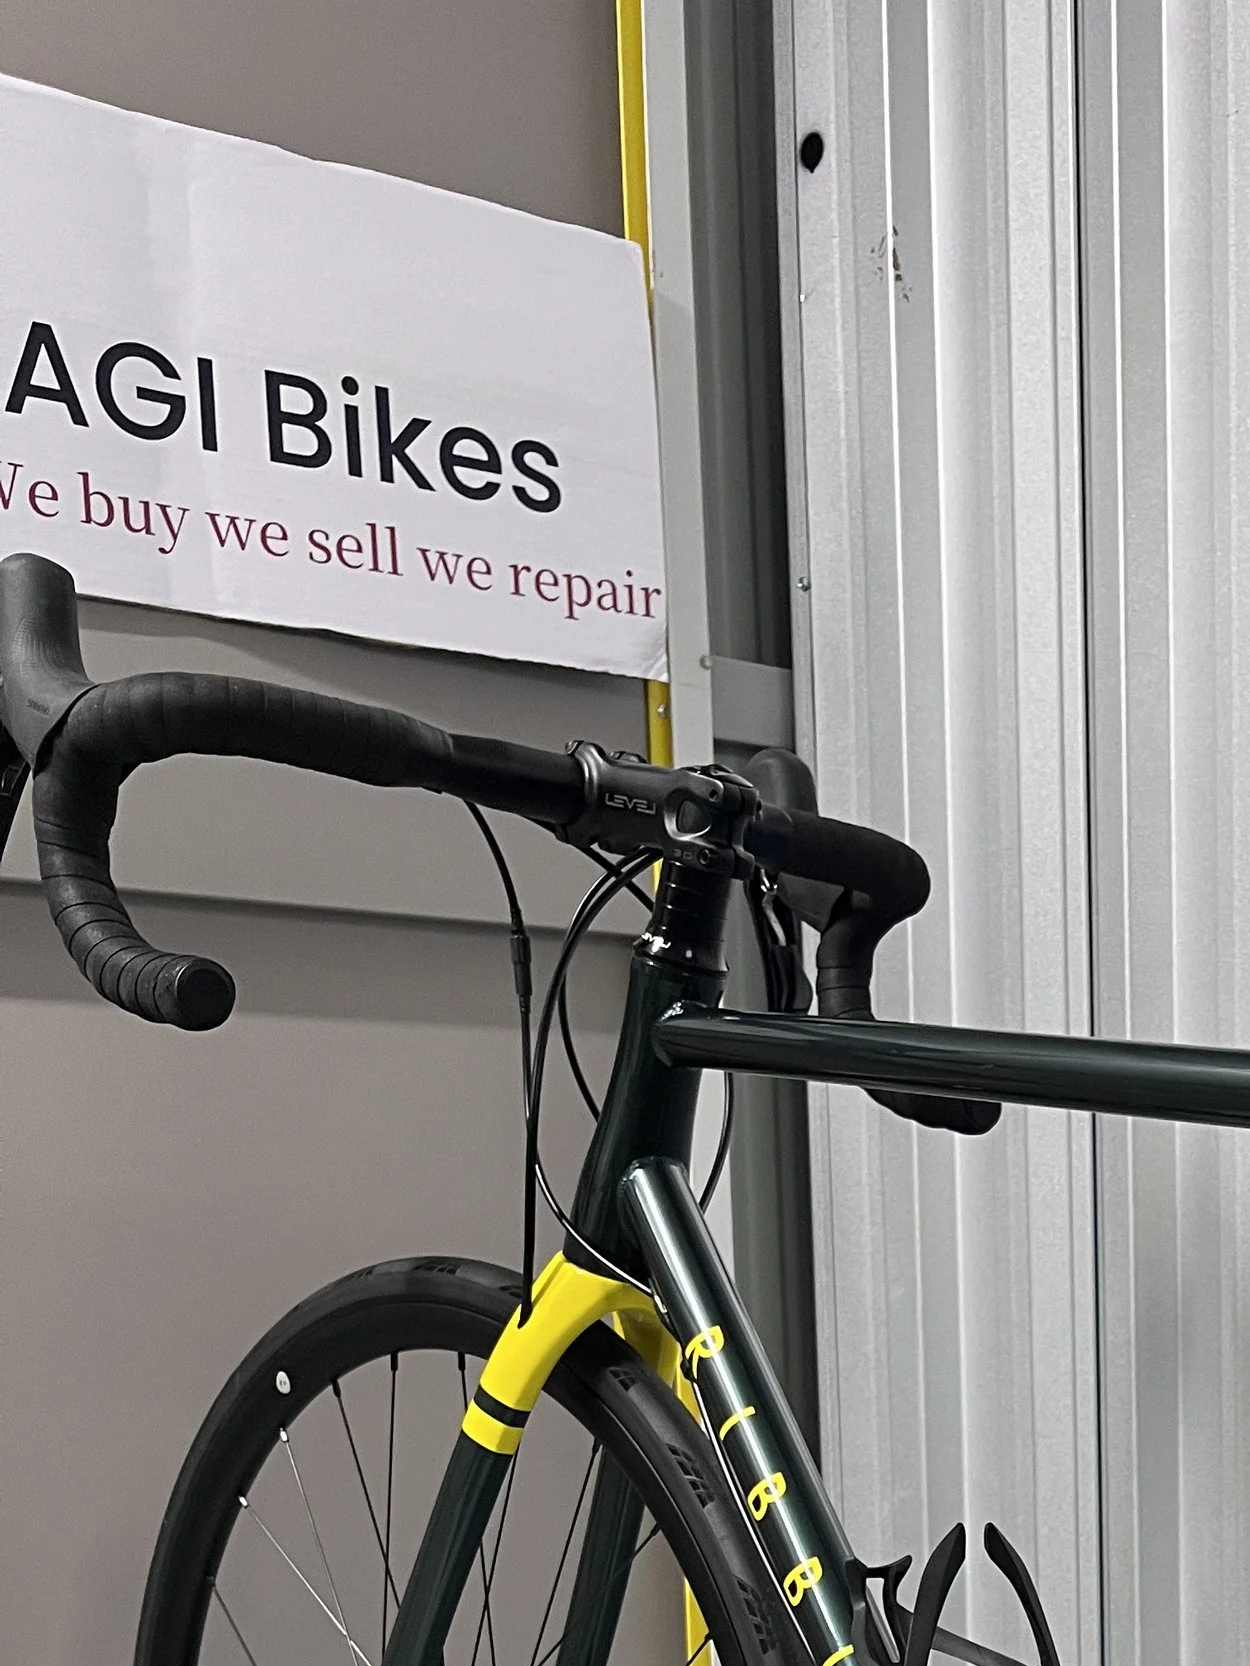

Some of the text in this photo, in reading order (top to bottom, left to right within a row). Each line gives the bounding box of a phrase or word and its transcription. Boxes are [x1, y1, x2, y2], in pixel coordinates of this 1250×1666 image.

[5, 320, 562, 513] AGI Bikes
[78, 472, 190, 554] buy
[205, 511, 289, 557] we
[307, 522, 404, 575] sell
[416, 549, 493, 590] we
[508, 562, 662, 621] repair
[604, 792, 656, 815] LEVEL
